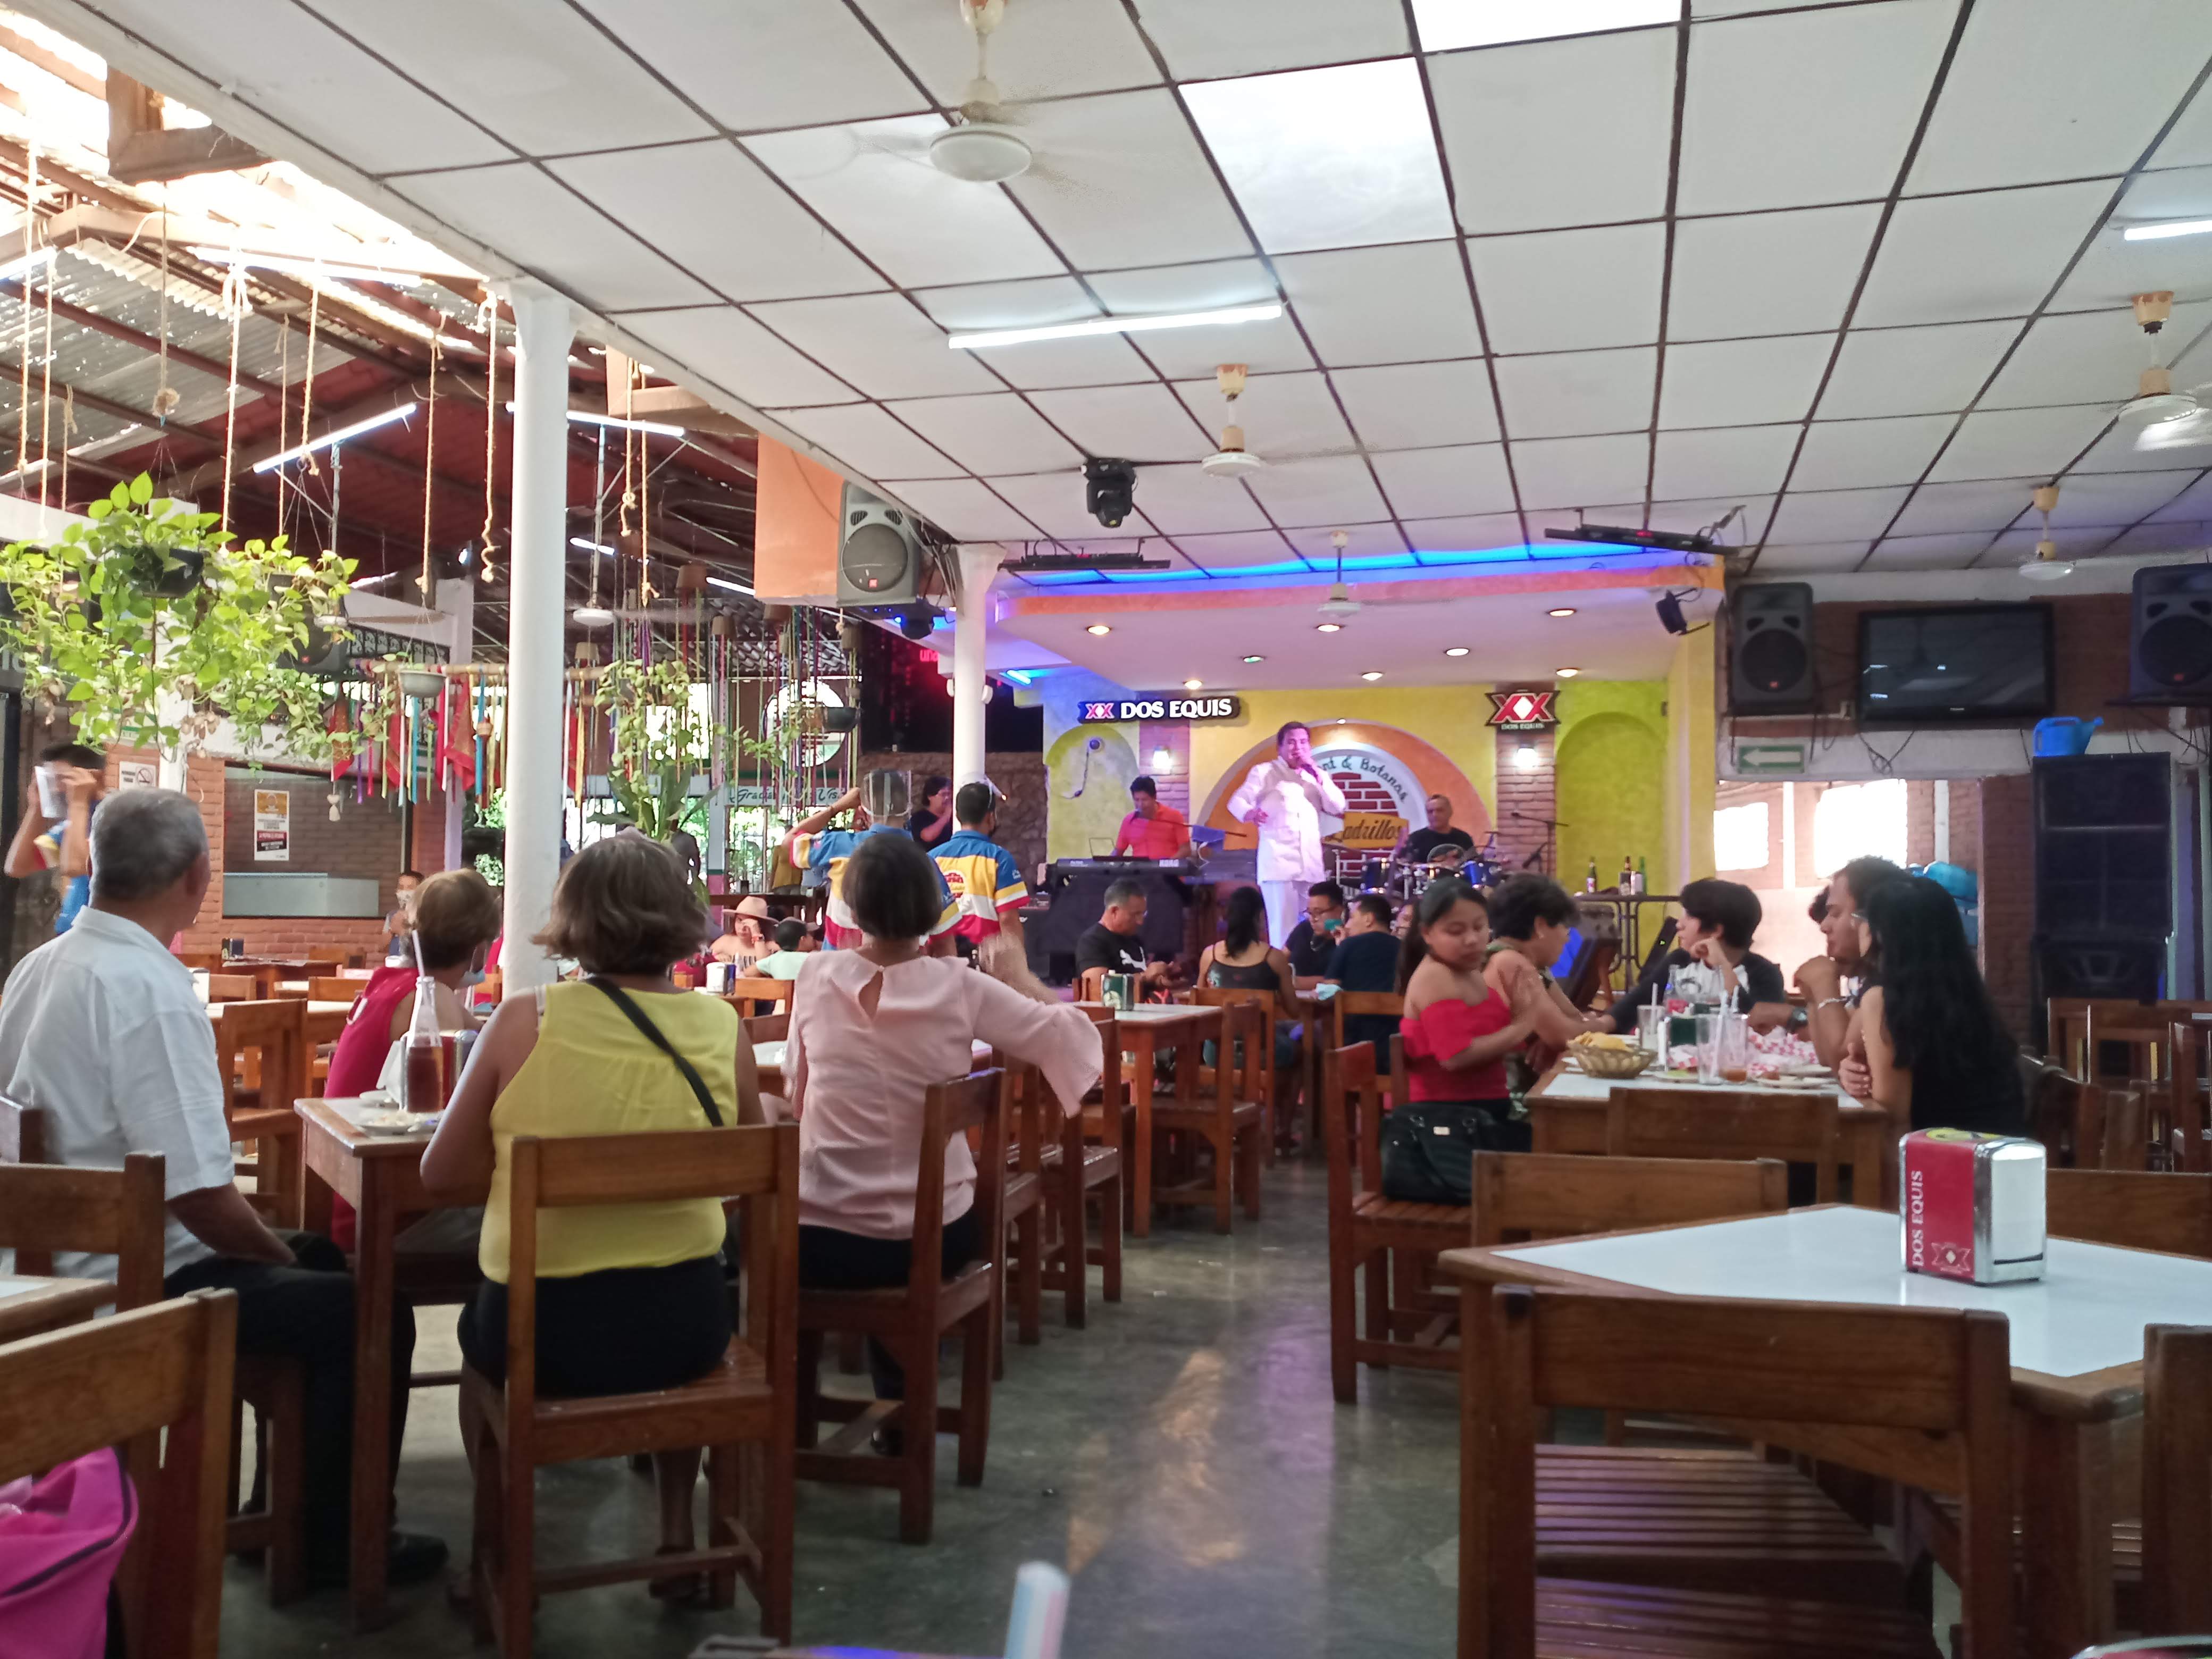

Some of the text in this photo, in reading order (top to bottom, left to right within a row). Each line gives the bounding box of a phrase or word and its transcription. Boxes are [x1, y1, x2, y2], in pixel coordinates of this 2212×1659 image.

[1121, 702, 1163, 718] DOS
[1170, 699, 1232, 718] EQUIS
[1361, 758, 1408, 802] Botanas
[1912, 1170, 1924, 1266] DOS EQUIS
